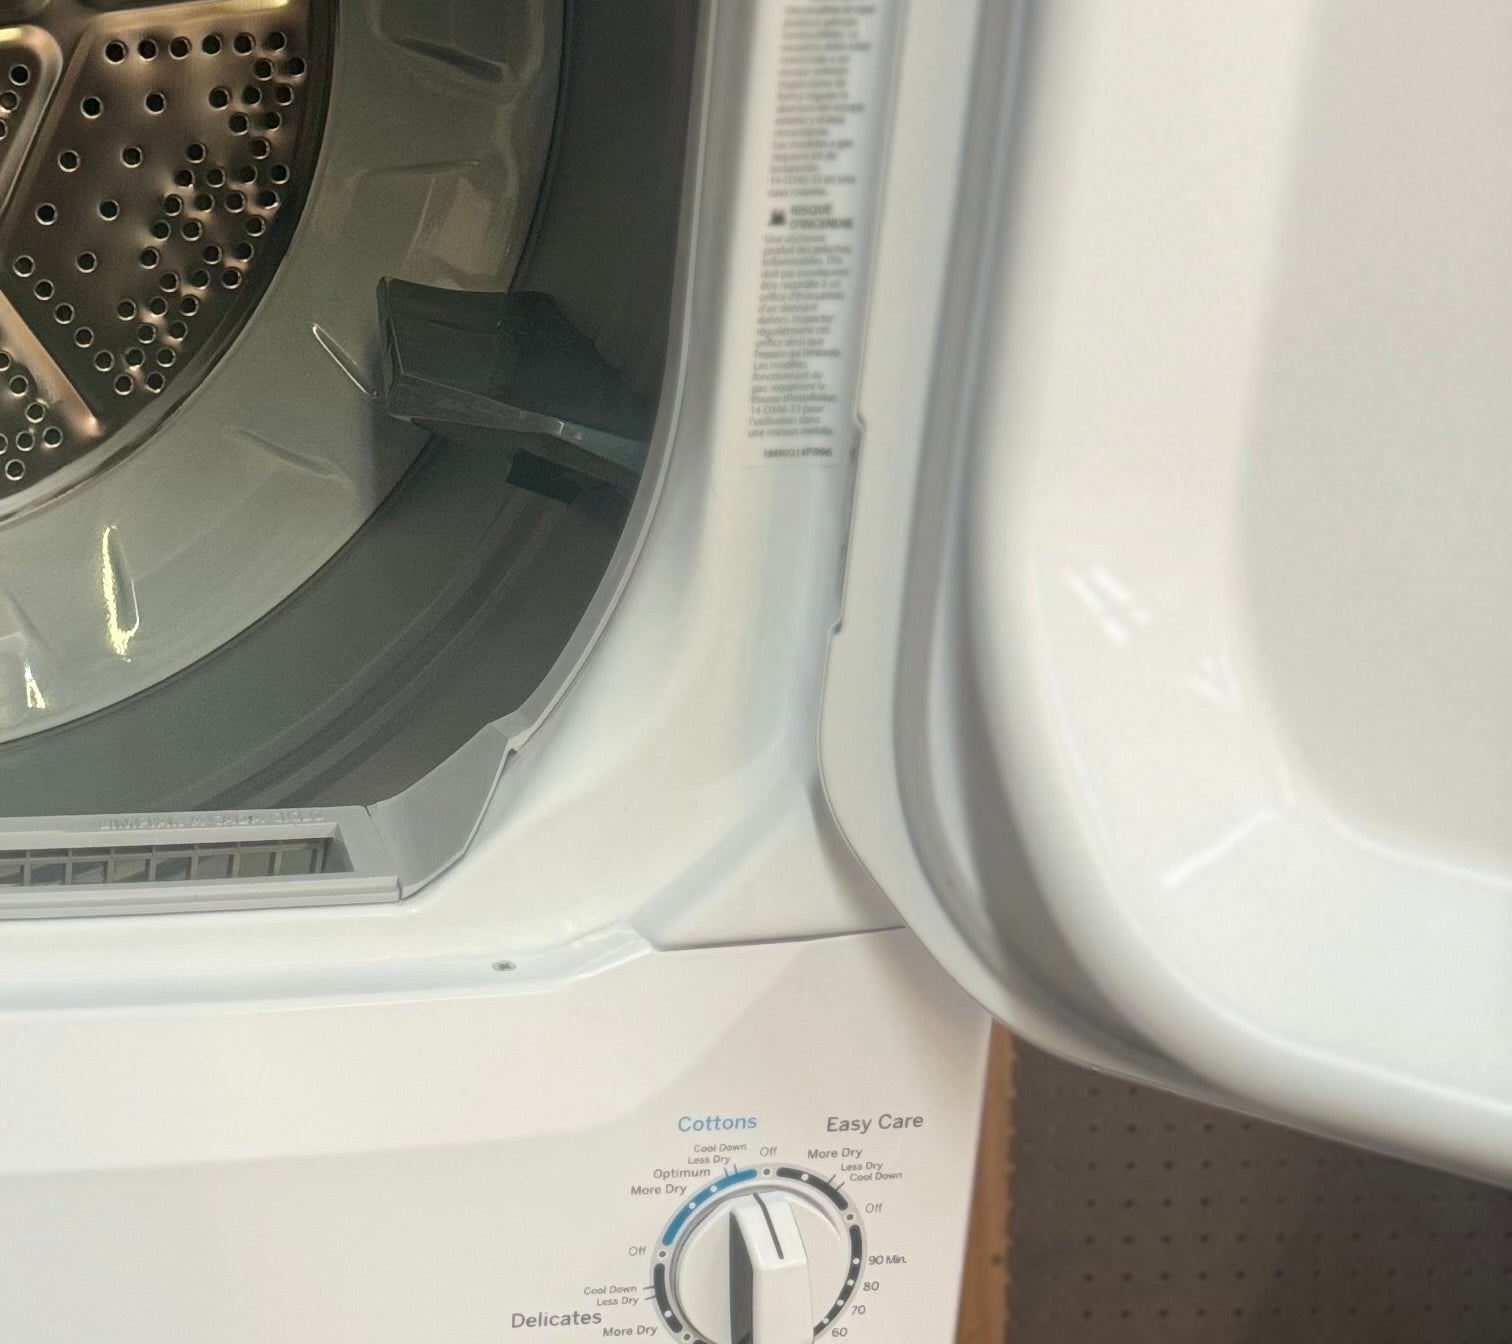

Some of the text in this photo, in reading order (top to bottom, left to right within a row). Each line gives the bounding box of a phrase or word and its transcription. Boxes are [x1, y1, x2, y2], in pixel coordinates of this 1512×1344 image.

[677, 1115, 758, 1132] Cottons
[826, 1114, 924, 1134] Easy Care
[693, 1143, 747, 1153] Cool Down
[759, 1146, 777, 1157] Off
[807, 1147, 863, 1161] More Dry
[688, 1154, 730, 1166] Less Dry
[840, 1160, 883, 1172] Less Dry
[653, 1167, 711, 1182] Optimum
[849, 1170, 903, 1182] Cool Down
[630, 1184, 687, 1198] More Dry
[865, 1202, 883, 1214] Off
[628, 1246, 647, 1257] Off
[868, 1255, 884, 1266] 90
[583, 1285, 637, 1296] Cool Down
[863, 1280, 880, 1293] 80
[596, 1296, 640, 1308] Less Dry
[851, 1305, 867, 1316] 70
[511, 1311, 603, 1329] Delicates
[602, 1325, 658, 1339] More Dry
[831, 1327, 848, 1339] 60
